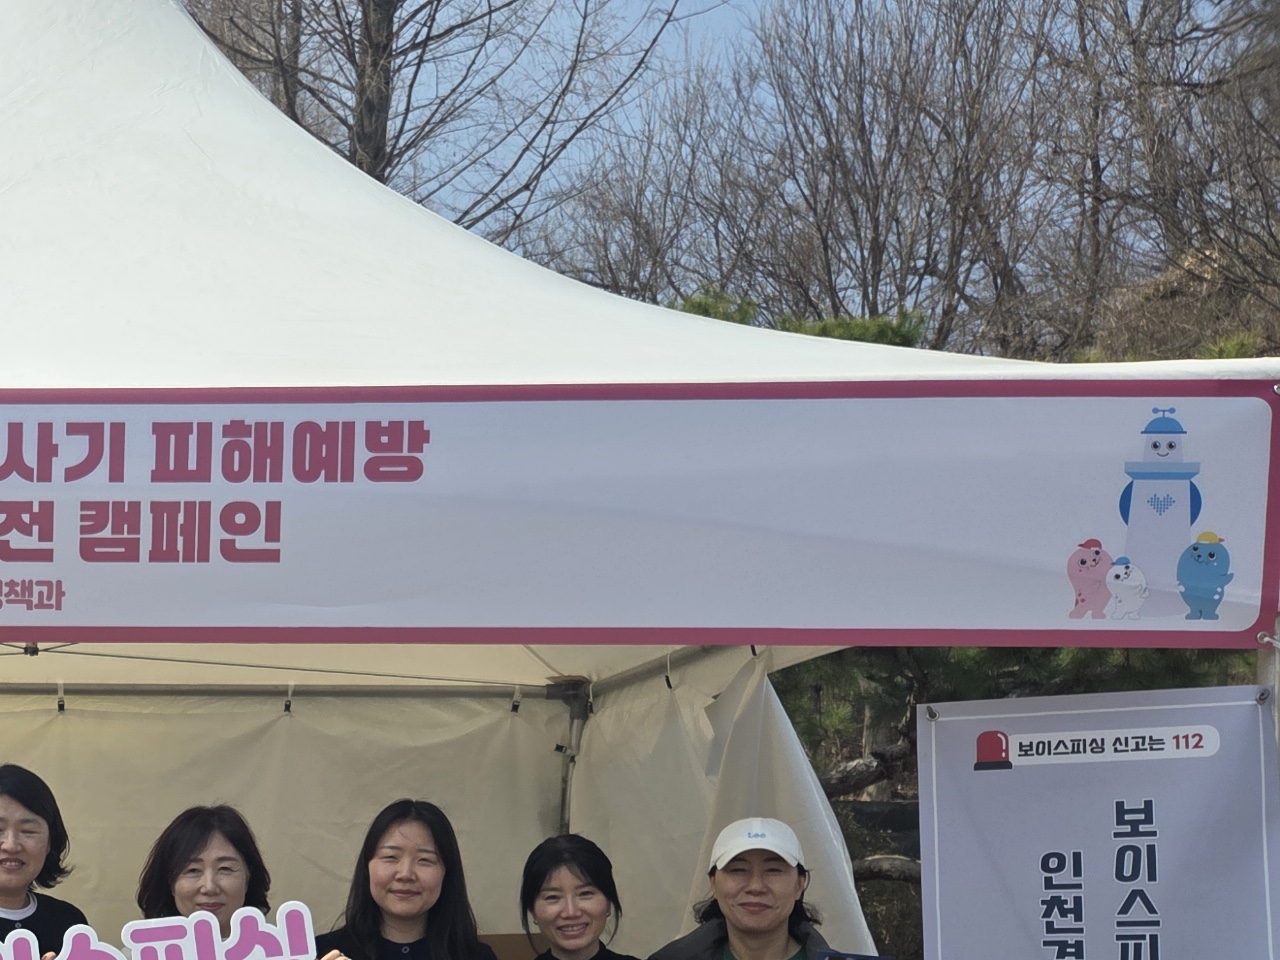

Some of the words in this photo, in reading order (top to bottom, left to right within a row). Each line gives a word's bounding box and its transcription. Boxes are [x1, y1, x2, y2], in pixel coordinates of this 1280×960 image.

[150, 419, 431, 484] 피해예방
[78, 499, 282, 563] 캠페인
[1017, 736, 1106, 758] 보이스피싱
[1111, 734, 1166, 754] 신고는
[1172, 732, 1205, 751] 112
